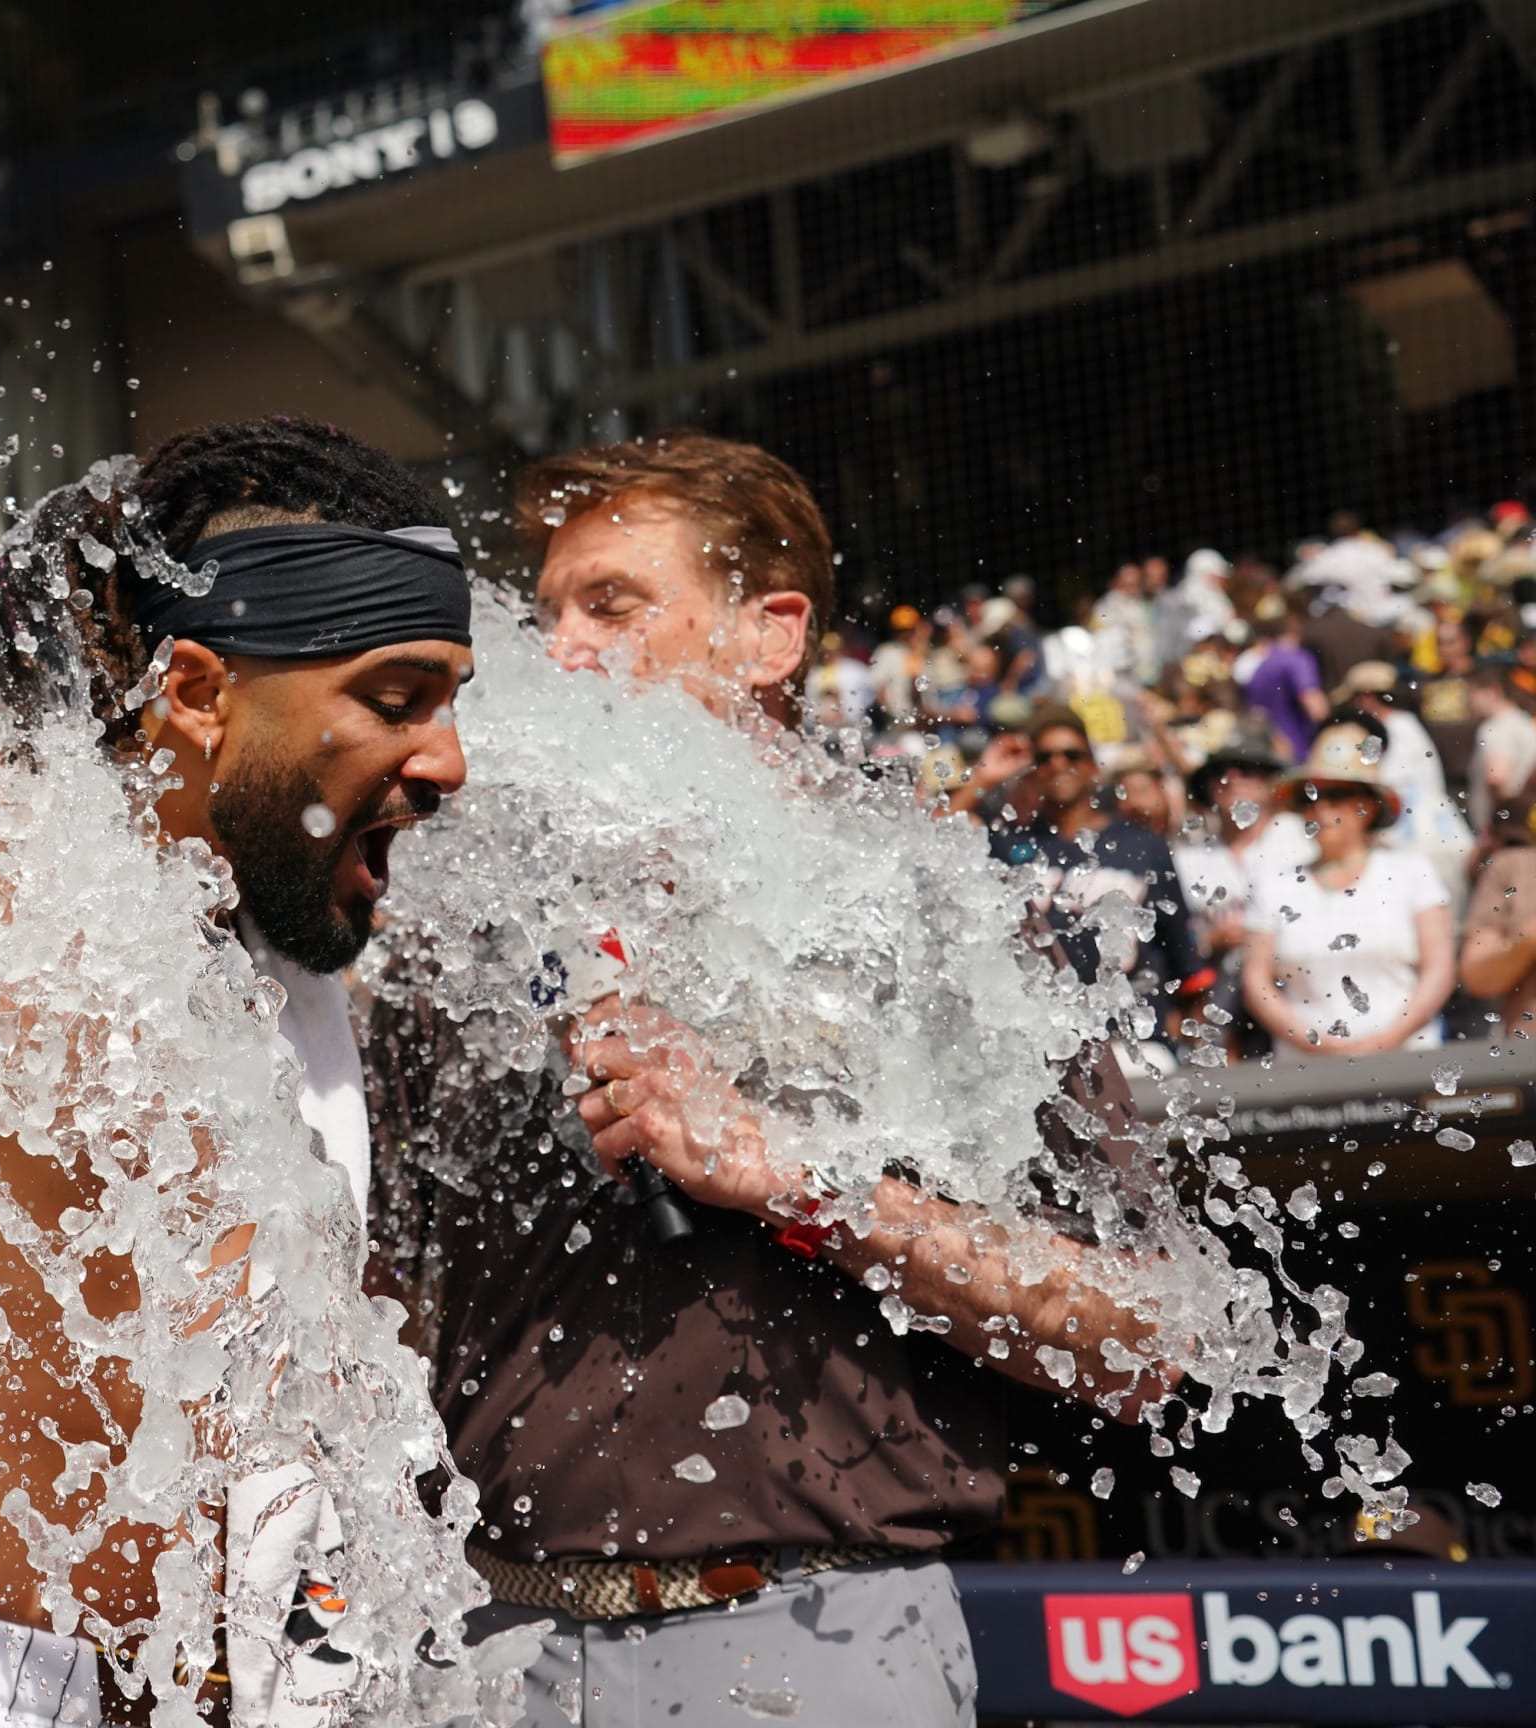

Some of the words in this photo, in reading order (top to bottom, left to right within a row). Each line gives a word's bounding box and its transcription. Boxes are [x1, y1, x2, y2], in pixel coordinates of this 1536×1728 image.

[241, 118, 425, 214] SONY
[1061, 1614, 1185, 1686] us
[1202, 1591, 1497, 1689] bank
